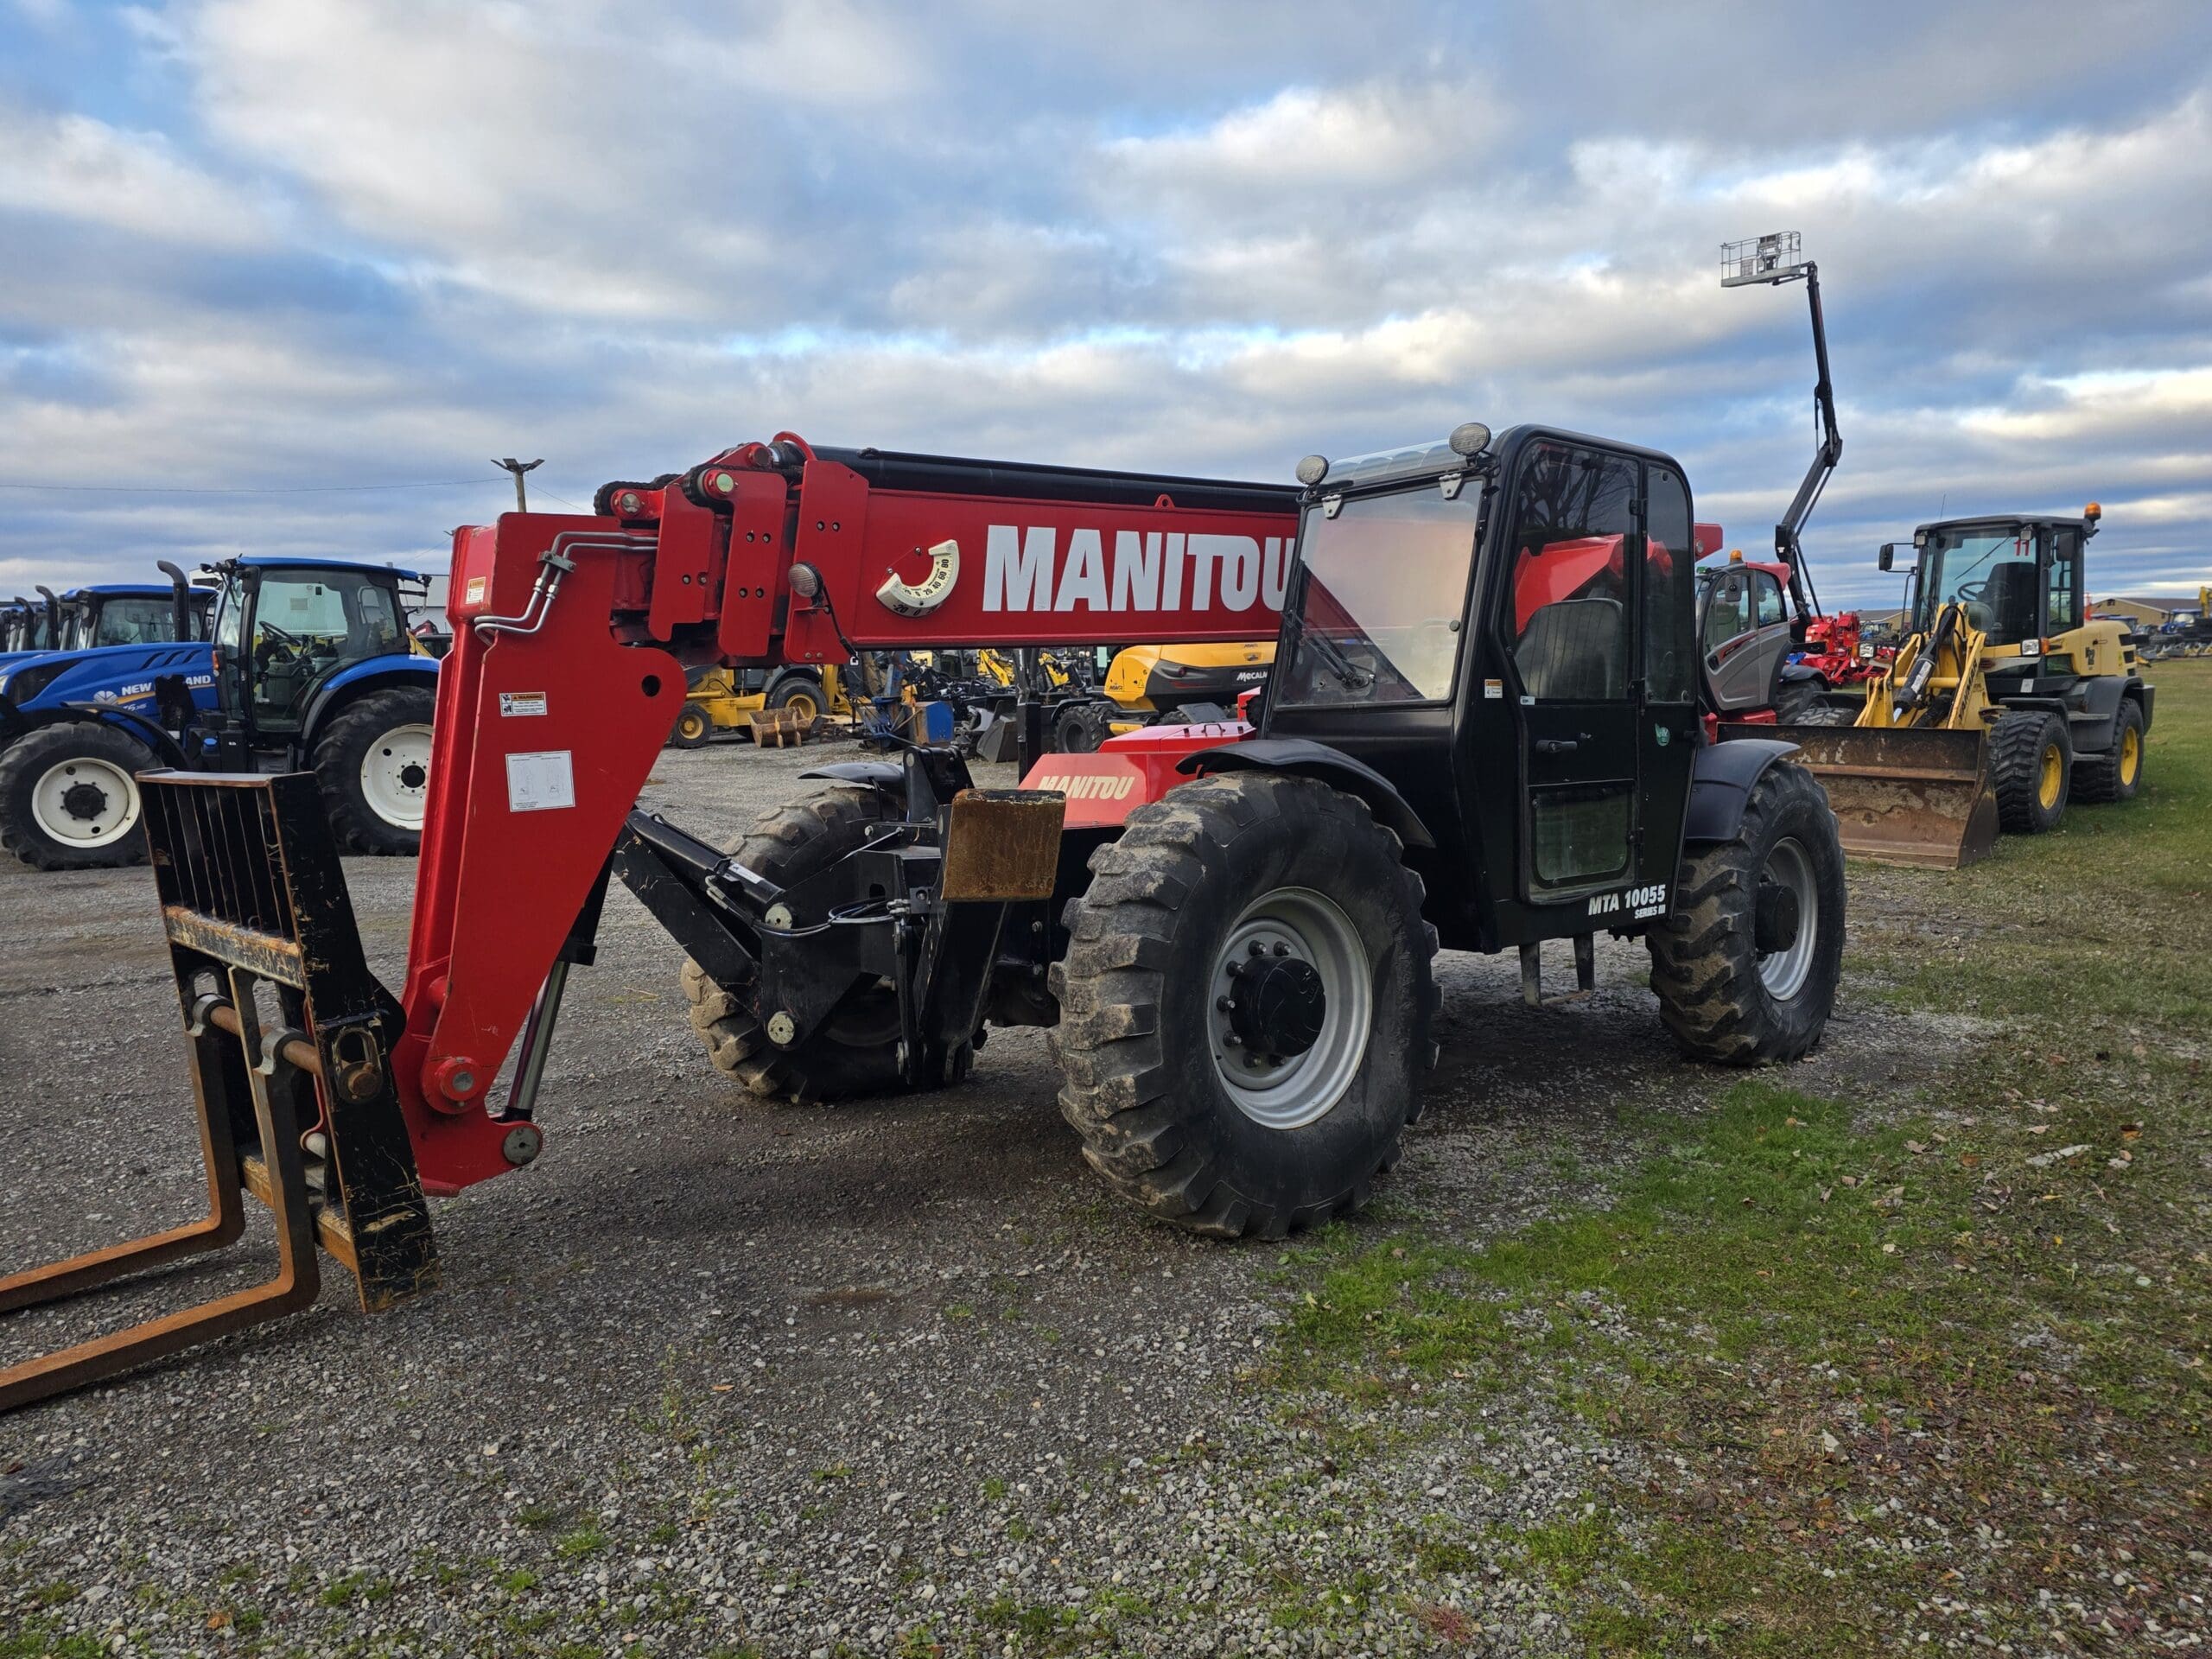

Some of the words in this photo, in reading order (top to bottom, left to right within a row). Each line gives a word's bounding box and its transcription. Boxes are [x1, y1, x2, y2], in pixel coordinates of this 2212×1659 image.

[2013, 539, 2030, 556] 11
[982, 524, 1295, 612] MANITOU
[122, 682, 152, 696] NEW
[1037, 776, 1135, 800] MANITOU
[1588, 893, 1620, 916] MTA
[1624, 884, 1666, 908] 10055
[1634, 906, 1658, 919] SERIES
